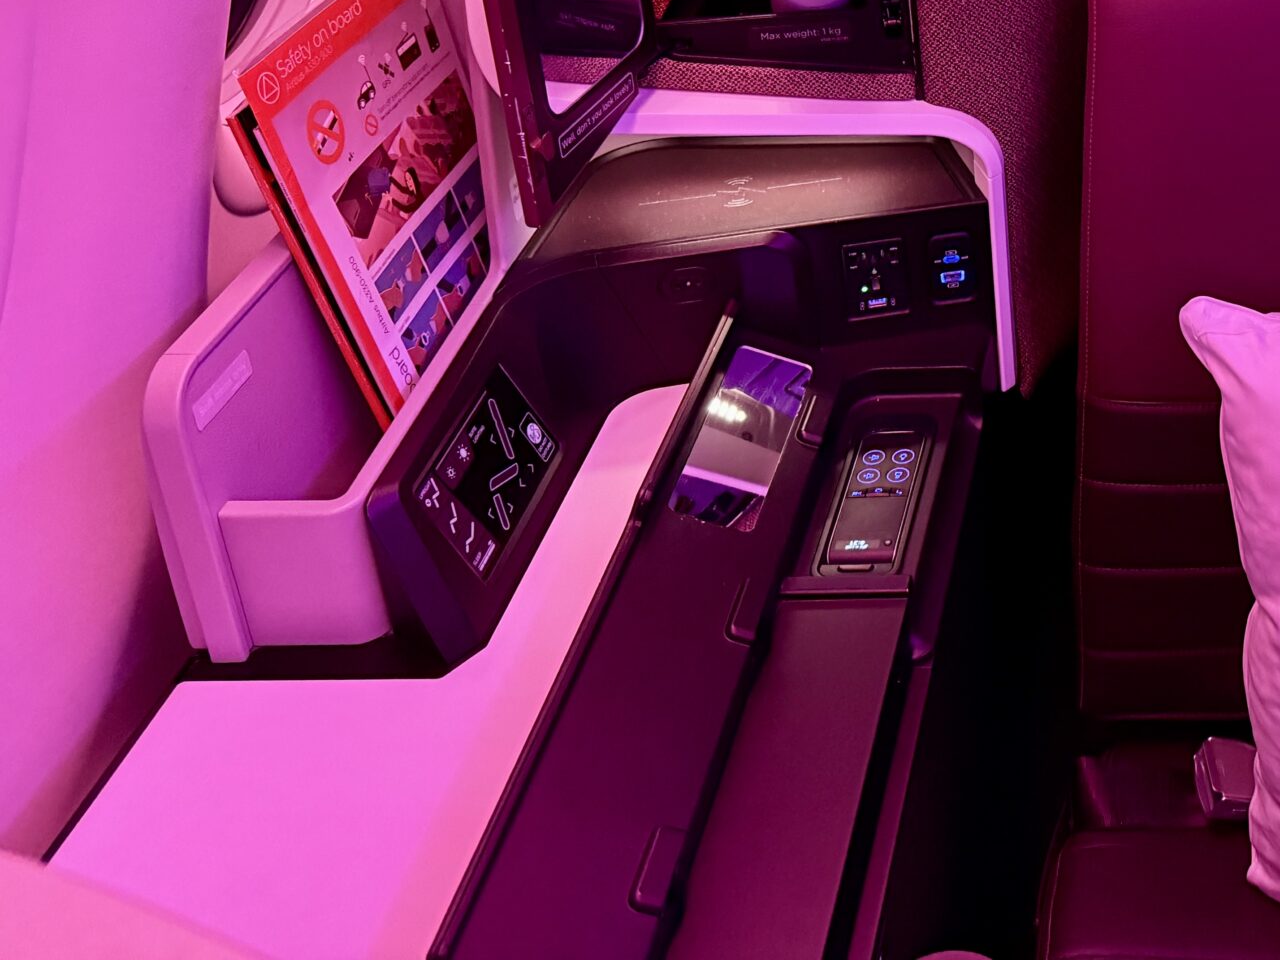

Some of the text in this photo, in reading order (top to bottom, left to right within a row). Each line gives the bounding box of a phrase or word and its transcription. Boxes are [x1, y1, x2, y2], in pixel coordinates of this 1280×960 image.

[760, 32, 781, 41] Max
[784, 28, 820, 39] weight:
[828, 27, 842, 36] kg
[276, 41, 312, 78] Safety
[313, 28, 329, 48] on
[591, 109, 603, 124] you
[373, 304, 390, 334] Airbus
